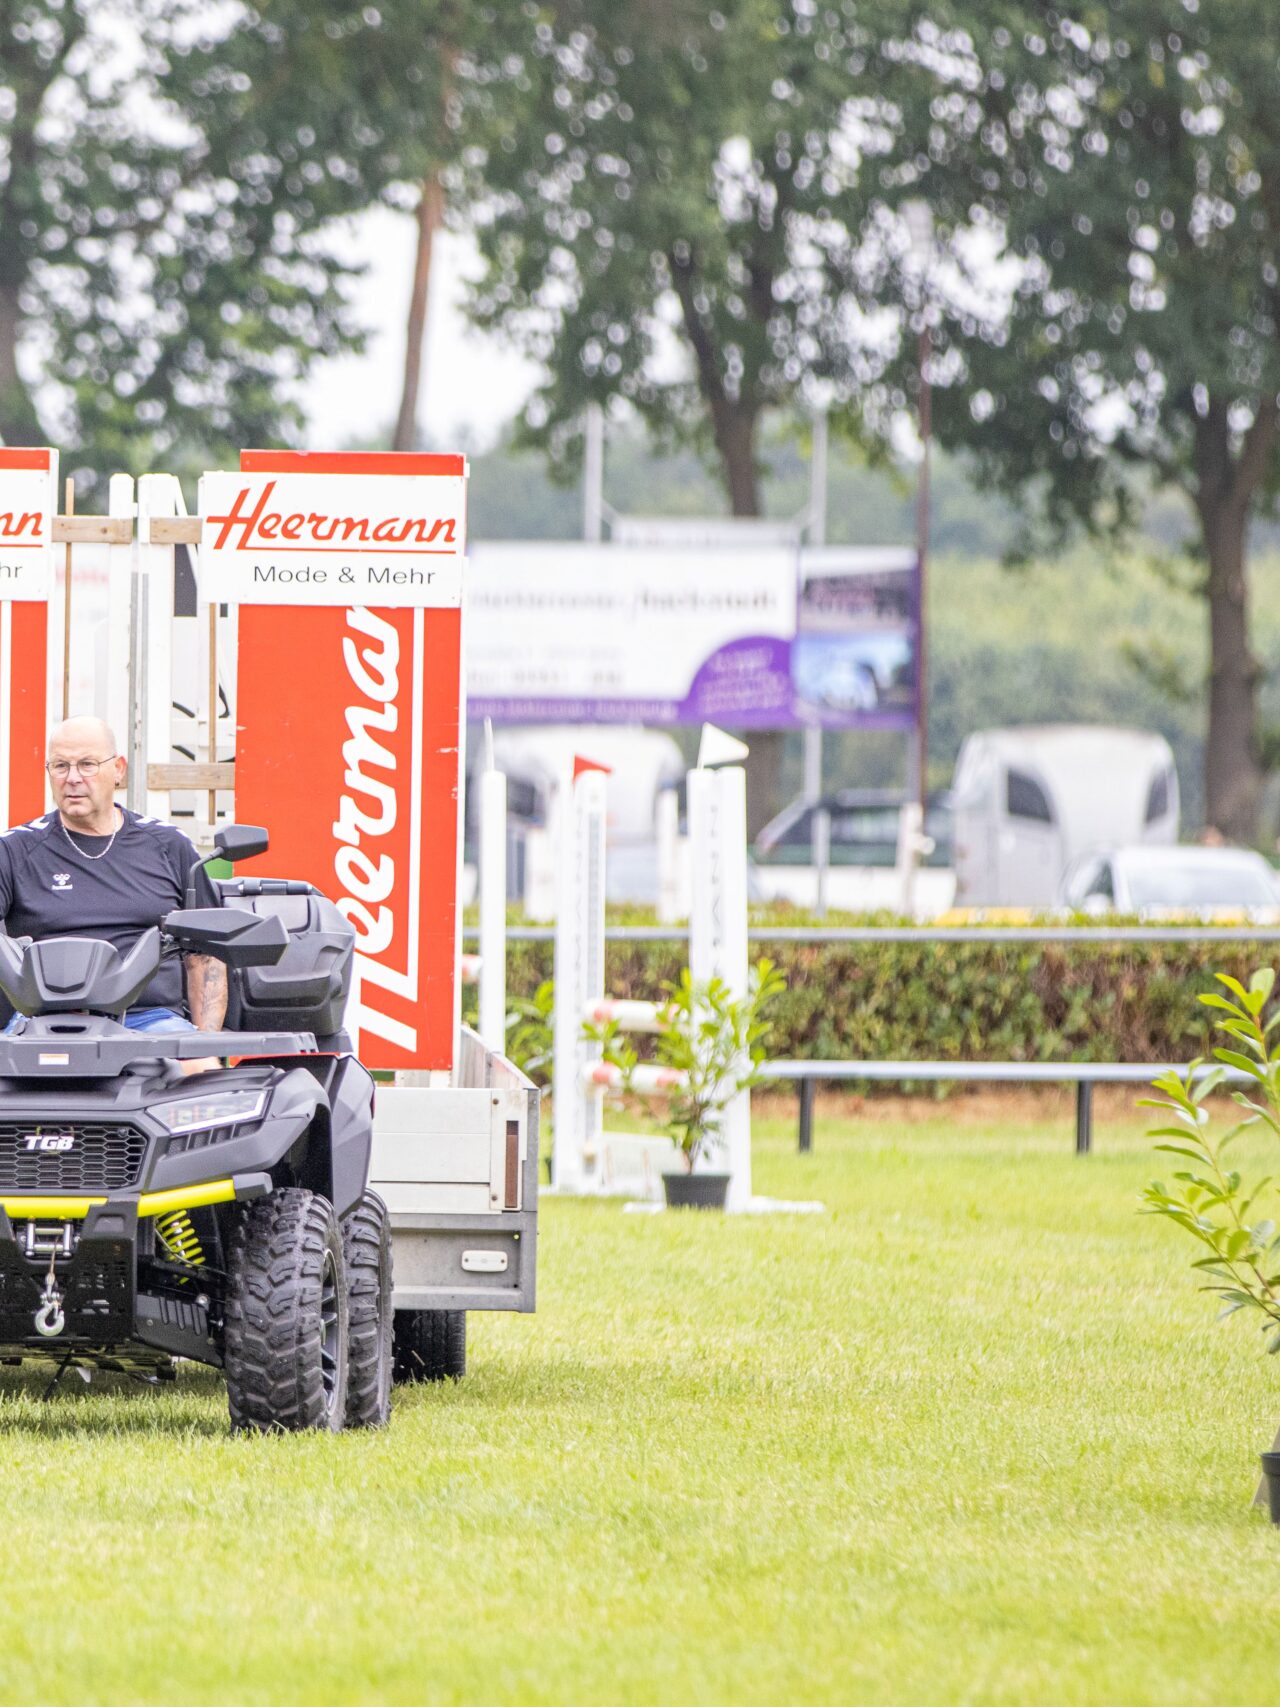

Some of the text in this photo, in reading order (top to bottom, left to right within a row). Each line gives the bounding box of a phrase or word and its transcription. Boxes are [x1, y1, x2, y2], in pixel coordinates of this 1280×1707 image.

[206, 480, 457, 554] Heermann
[253, 565, 436, 585] Mode & Mehr
[24, 1135, 75, 1150] TGB
